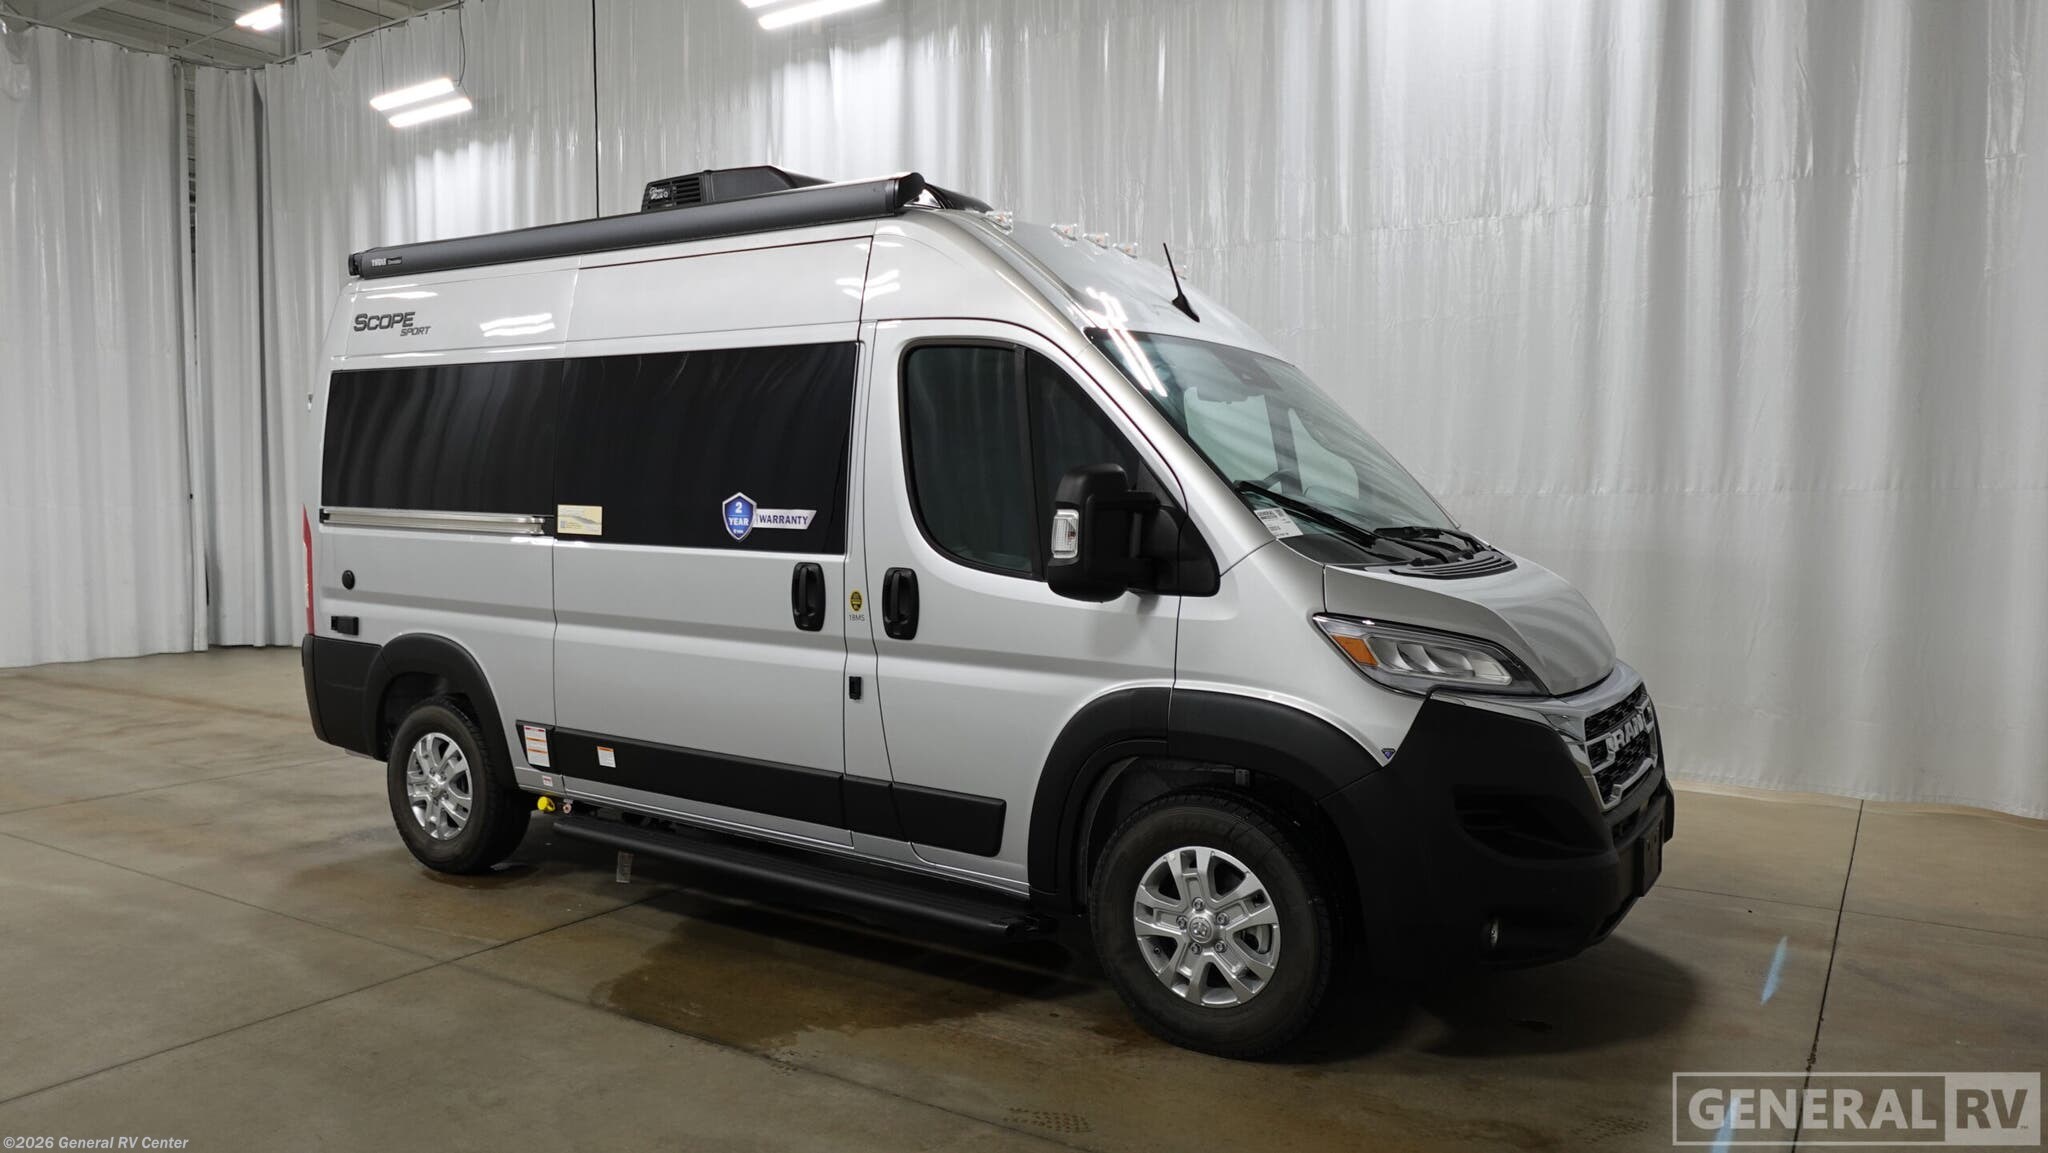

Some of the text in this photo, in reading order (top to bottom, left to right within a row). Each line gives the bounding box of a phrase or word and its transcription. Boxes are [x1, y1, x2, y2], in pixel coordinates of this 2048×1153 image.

[353, 311, 416, 332] SCOPE
[400, 326, 431, 337] SPORT
[735, 501, 743, 514] 2
[728, 517, 749, 526] YEAR
[759, 514, 809, 525] WARRANTY
[1606, 714, 1644, 753] RAM
